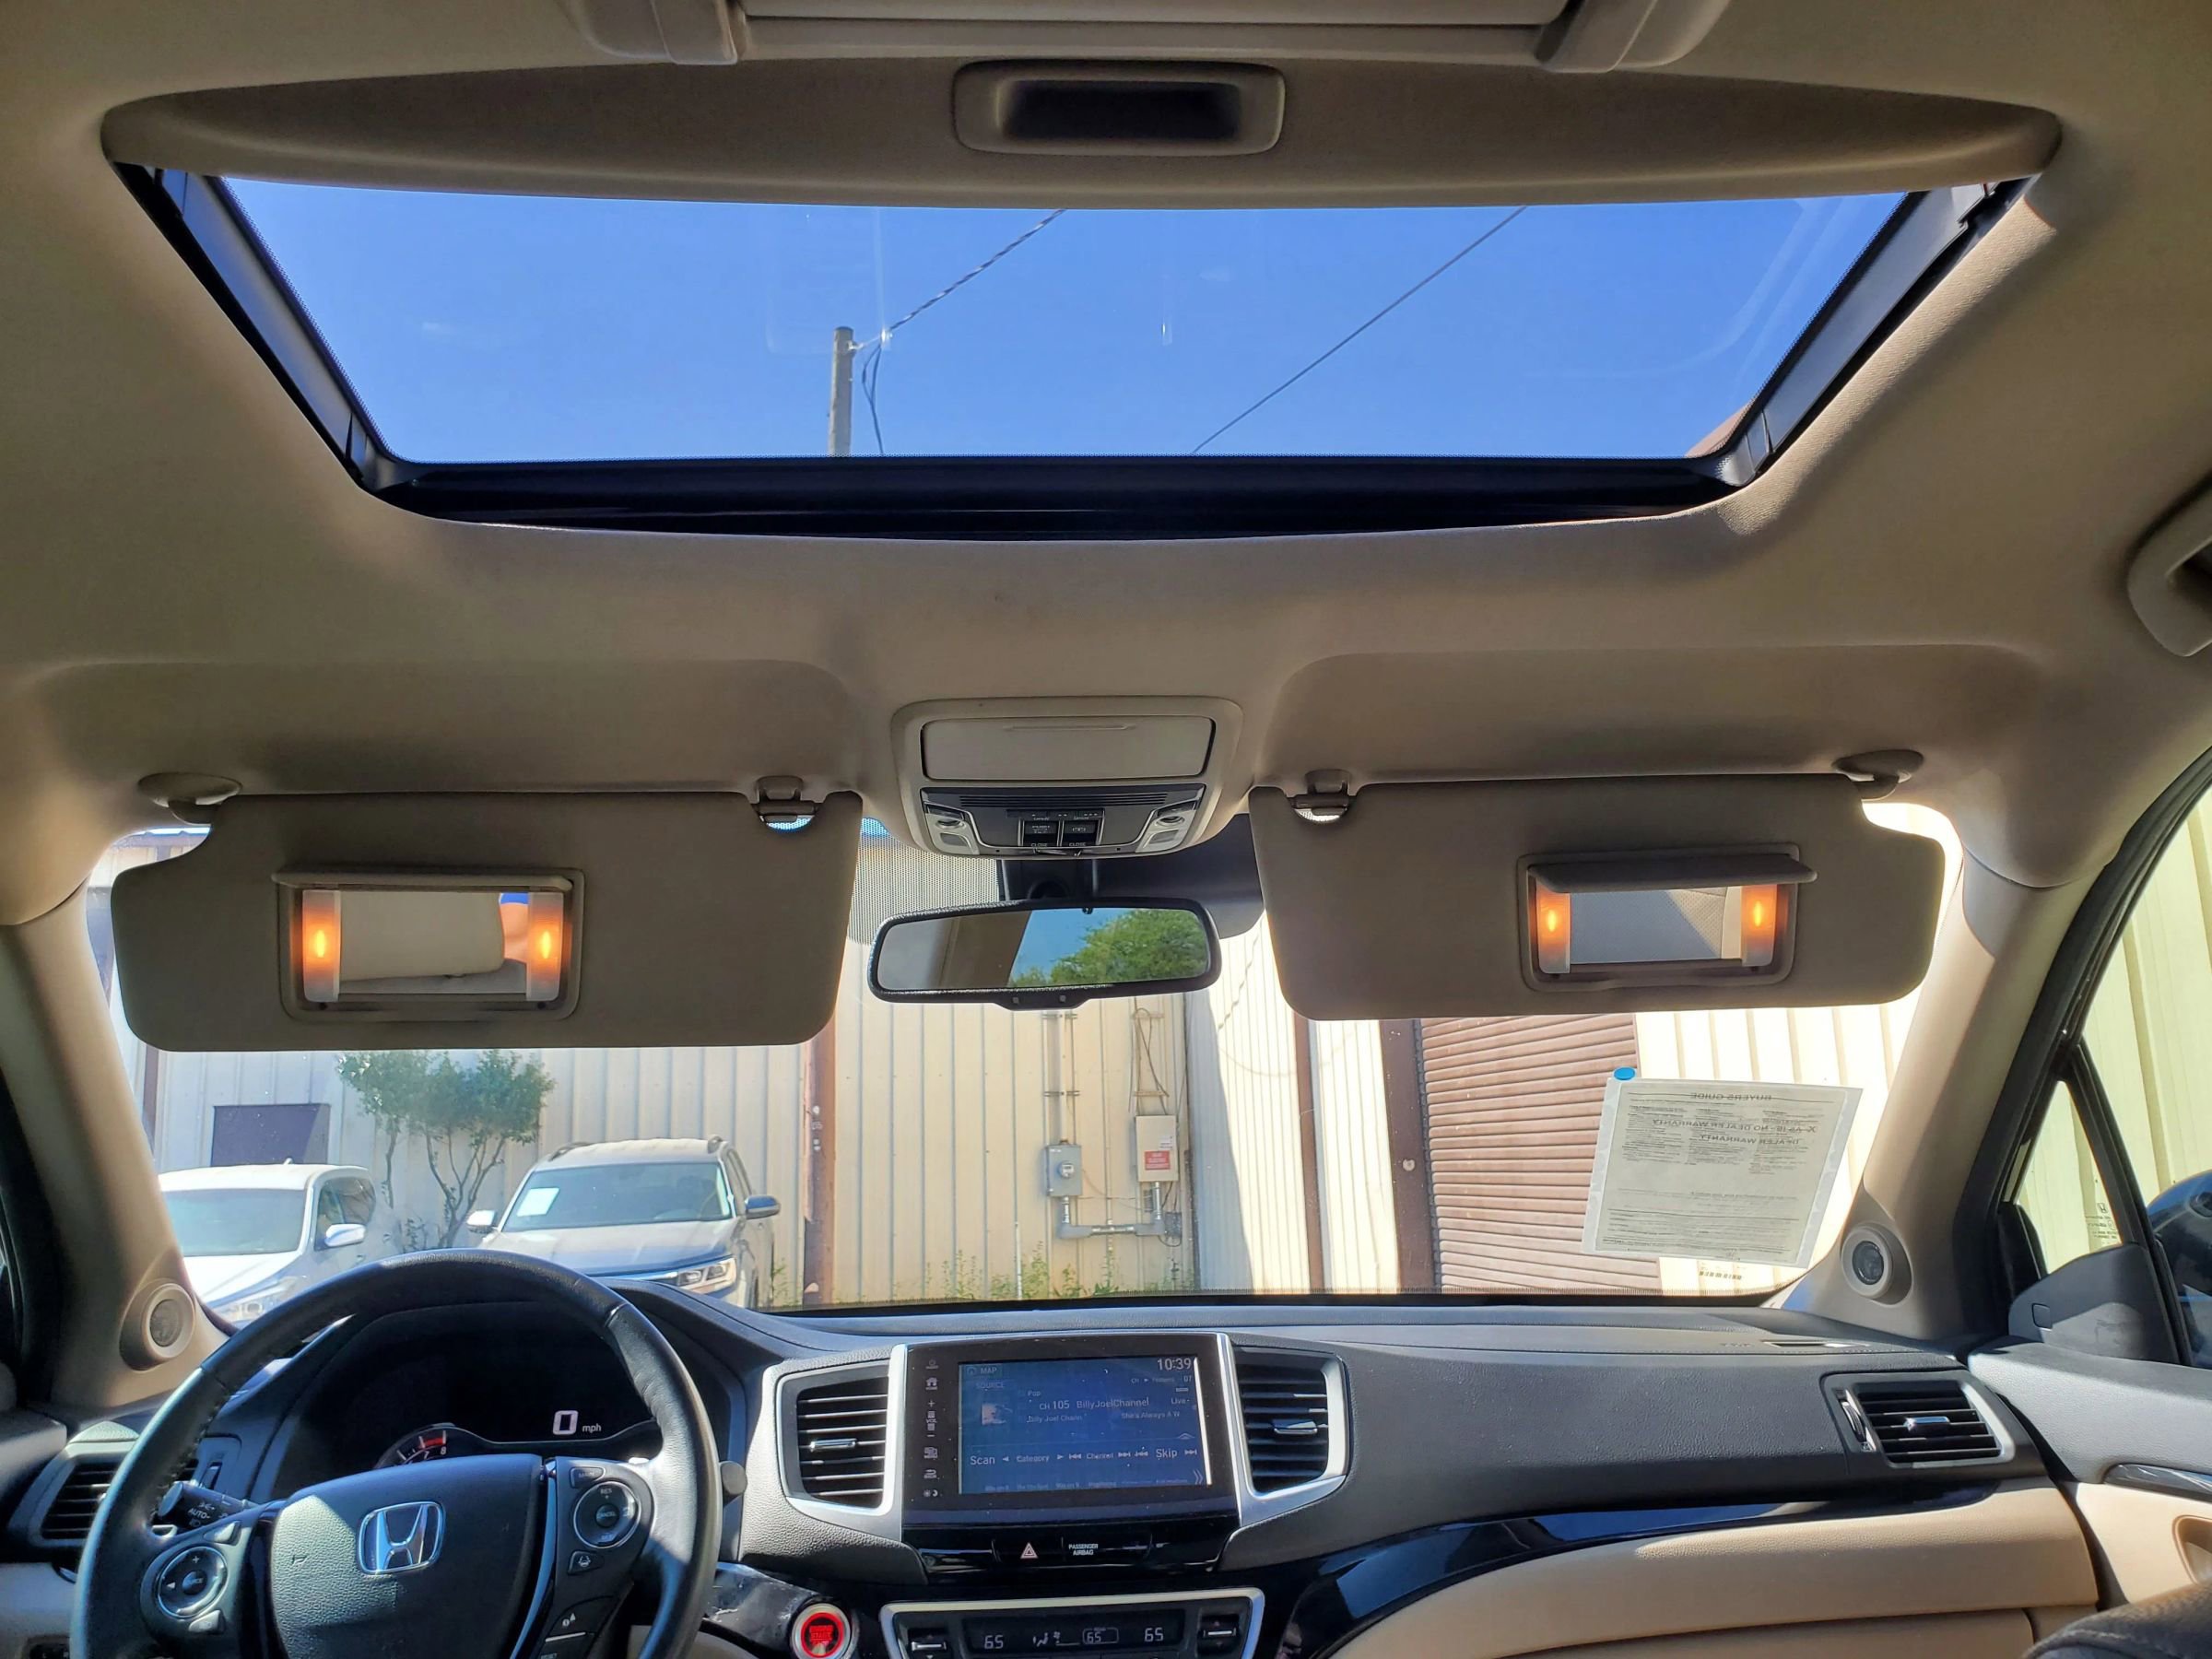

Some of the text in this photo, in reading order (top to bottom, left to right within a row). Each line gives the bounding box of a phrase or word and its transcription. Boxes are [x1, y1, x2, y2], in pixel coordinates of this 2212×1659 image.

[1157, 1357, 1192, 1371] 10:39
[980, 1367, 997, 1375] MAP
[1053, 1400, 1071, 1410] 105
[582, 1424, 602, 1434] mph
[440, 1445, 447, 1455] 8
[1086, 1451, 1114, 1460] Channel
[1155, 1447, 1178, 1461] Skip
[970, 1454, 995, 1466] Scan
[1016, 1453, 1050, 1464] Category
[187, 1508, 208, 1519] AUTO
[1068, 1543, 1100, 1551] PASSENGER
[1086, 1630, 1102, 1644] 65
[1144, 1627, 1165, 1642] 65
[983, 1634, 1005, 1650] 65
